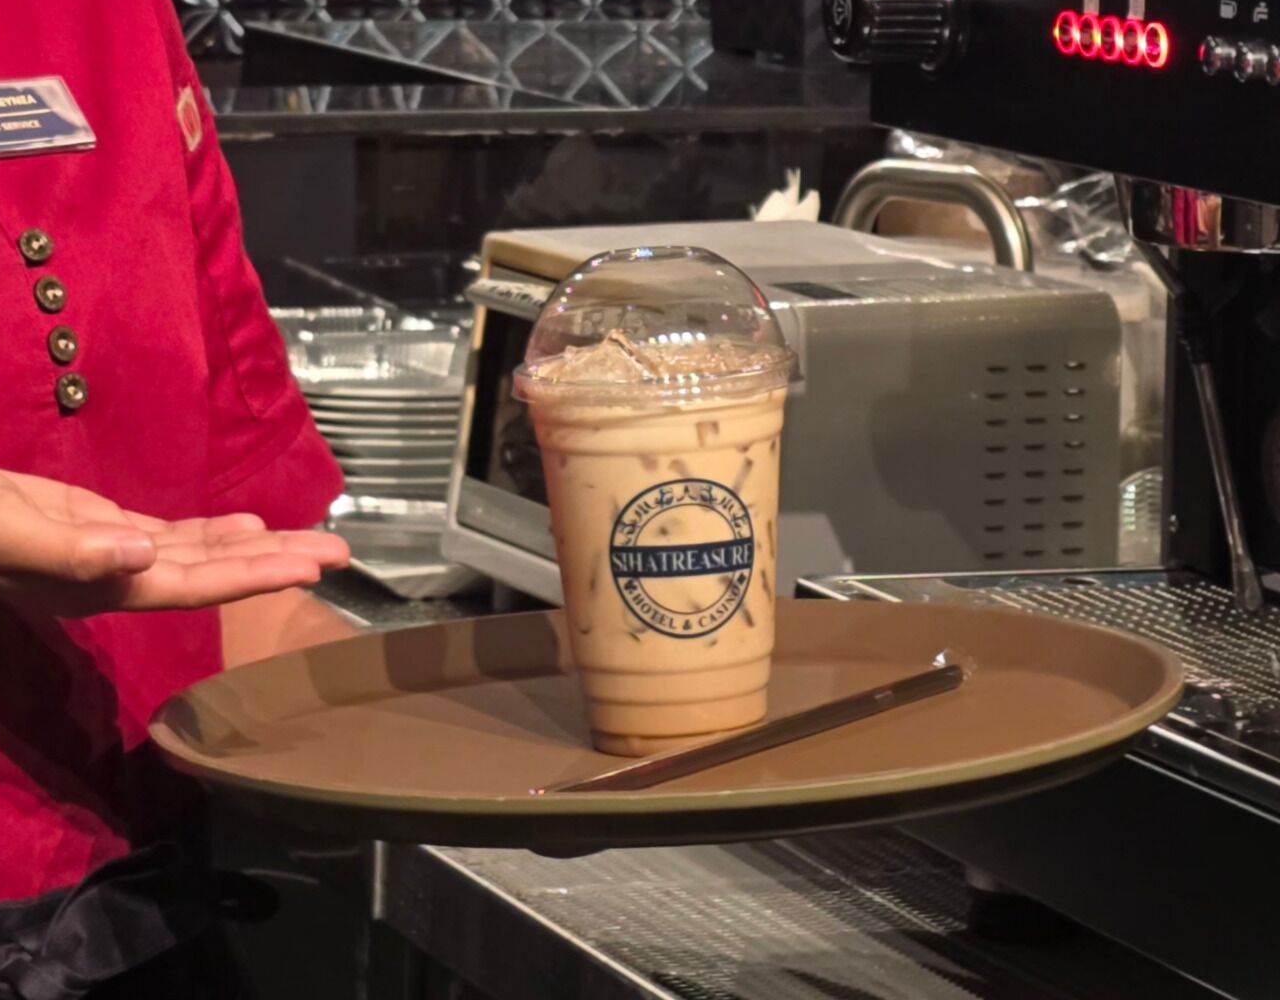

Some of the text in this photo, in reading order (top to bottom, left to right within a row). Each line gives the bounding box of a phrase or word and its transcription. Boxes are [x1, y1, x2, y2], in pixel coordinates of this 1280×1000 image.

[1, 120, 40, 131] SERVICE
[612, 544, 752, 572] SIHATREASURE
[632, 585, 740, 631] HOTEL & CASINO
